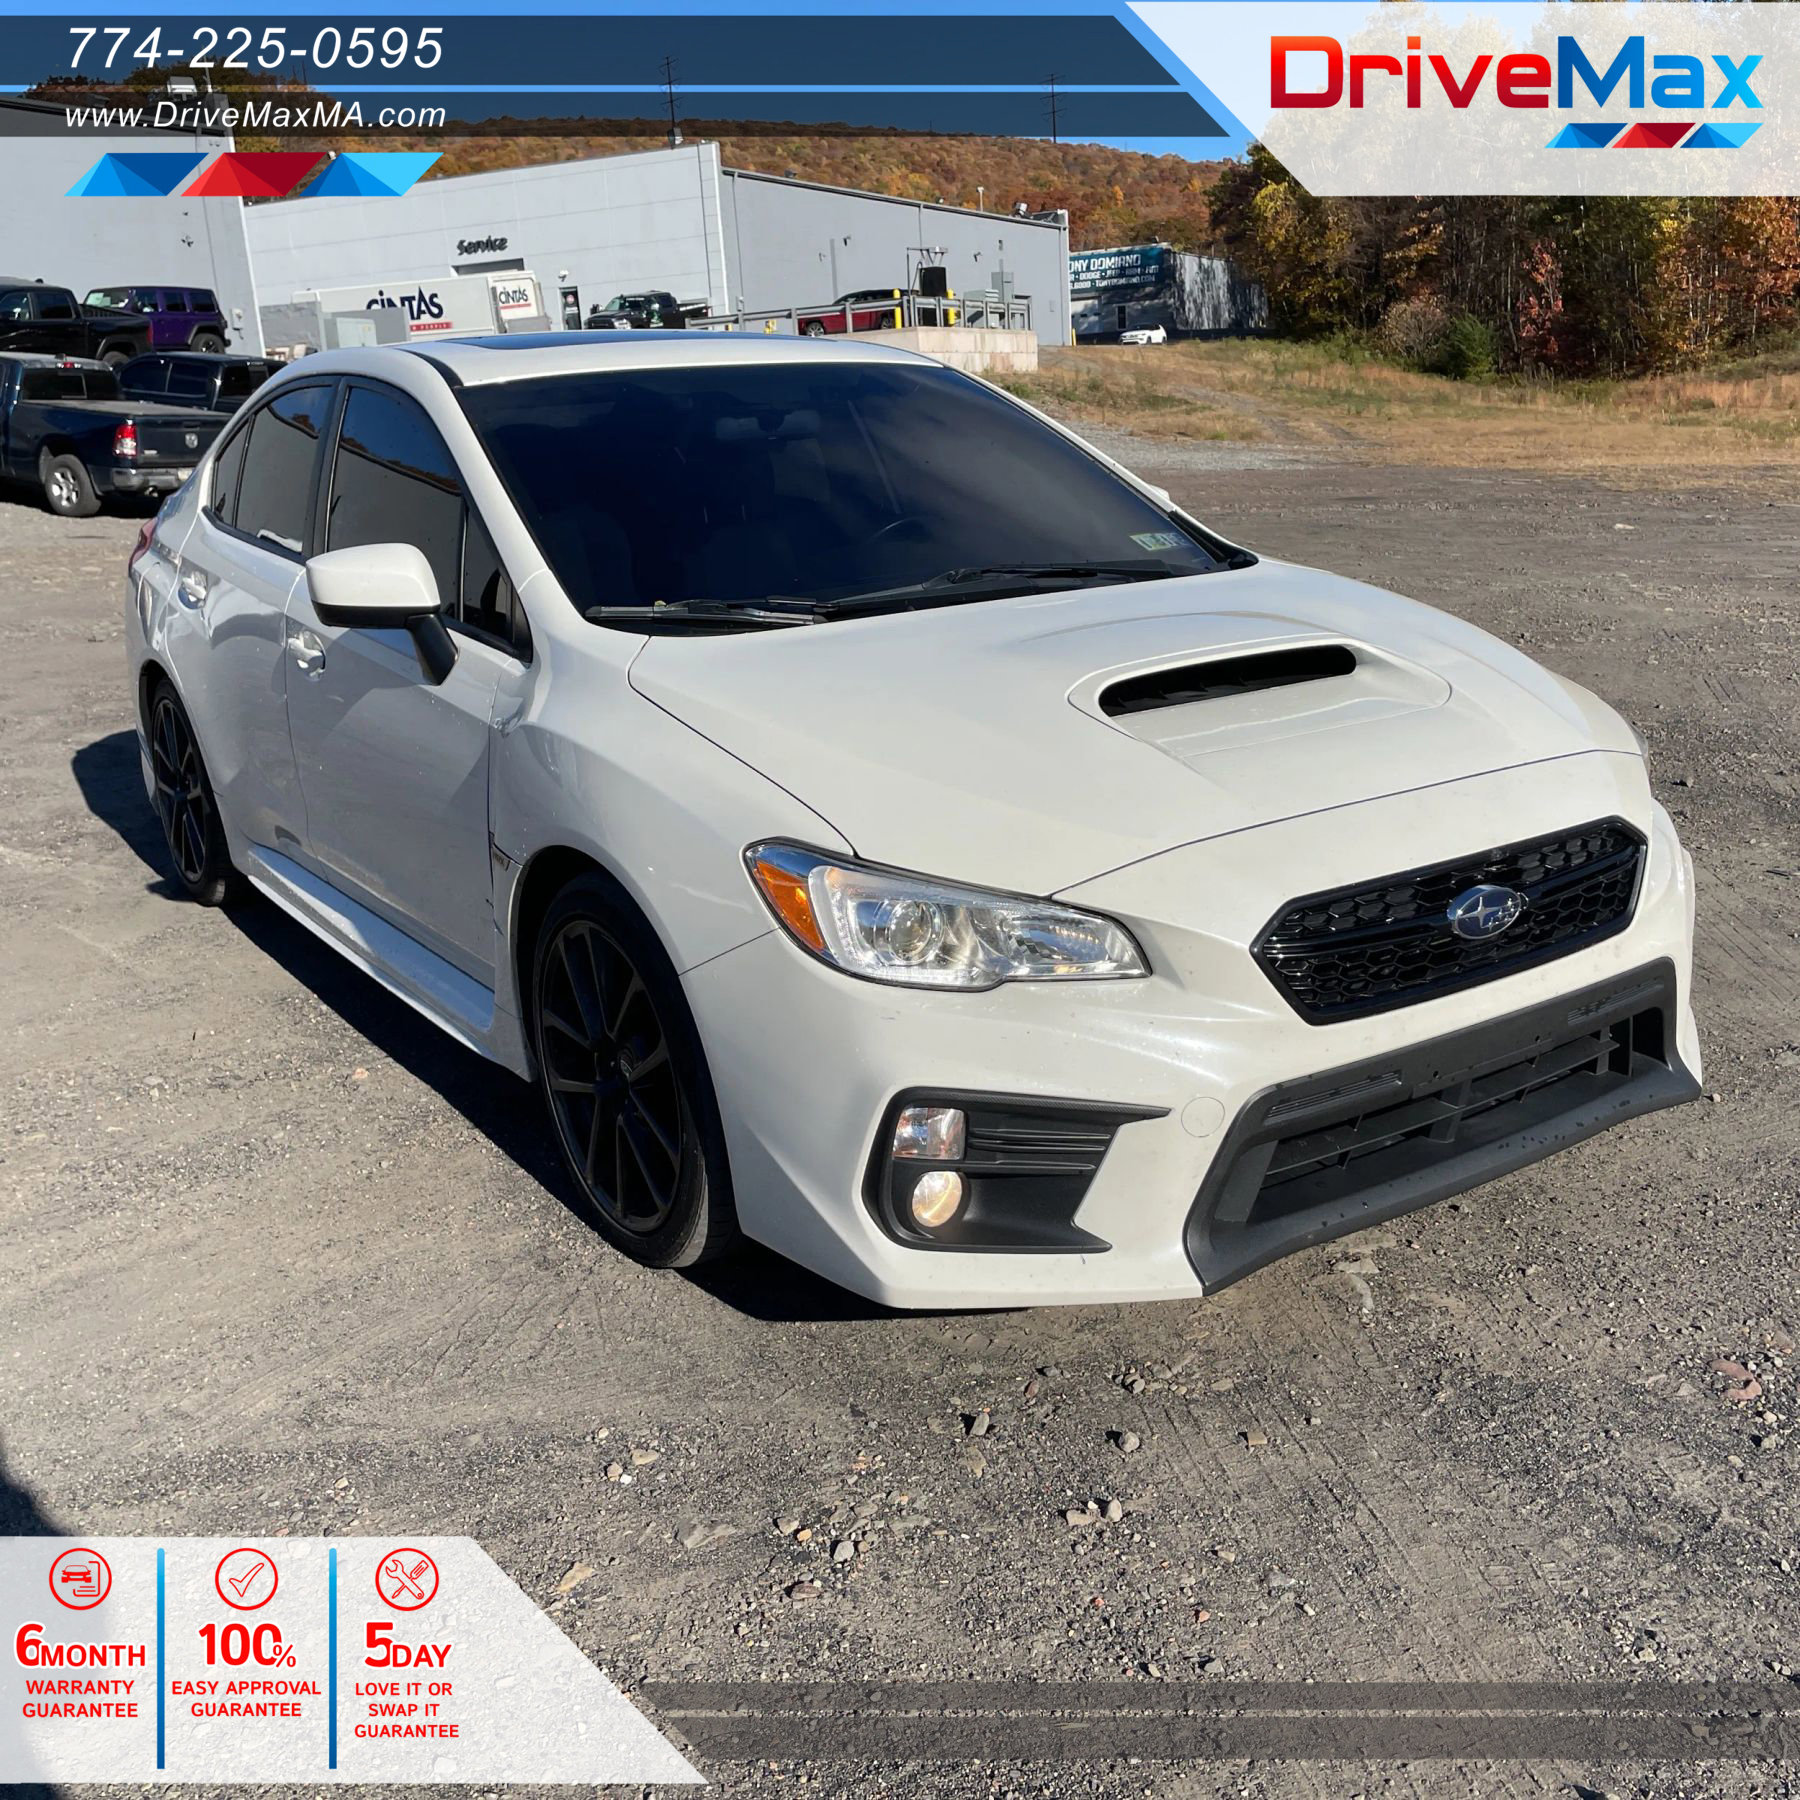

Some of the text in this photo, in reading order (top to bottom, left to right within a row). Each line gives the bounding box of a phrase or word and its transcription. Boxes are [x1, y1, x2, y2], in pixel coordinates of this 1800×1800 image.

[457, 235, 508, 256] Service
[1089, 254, 1141, 270] DOMIANO
[1079, 271, 1101, 281] DODGE
